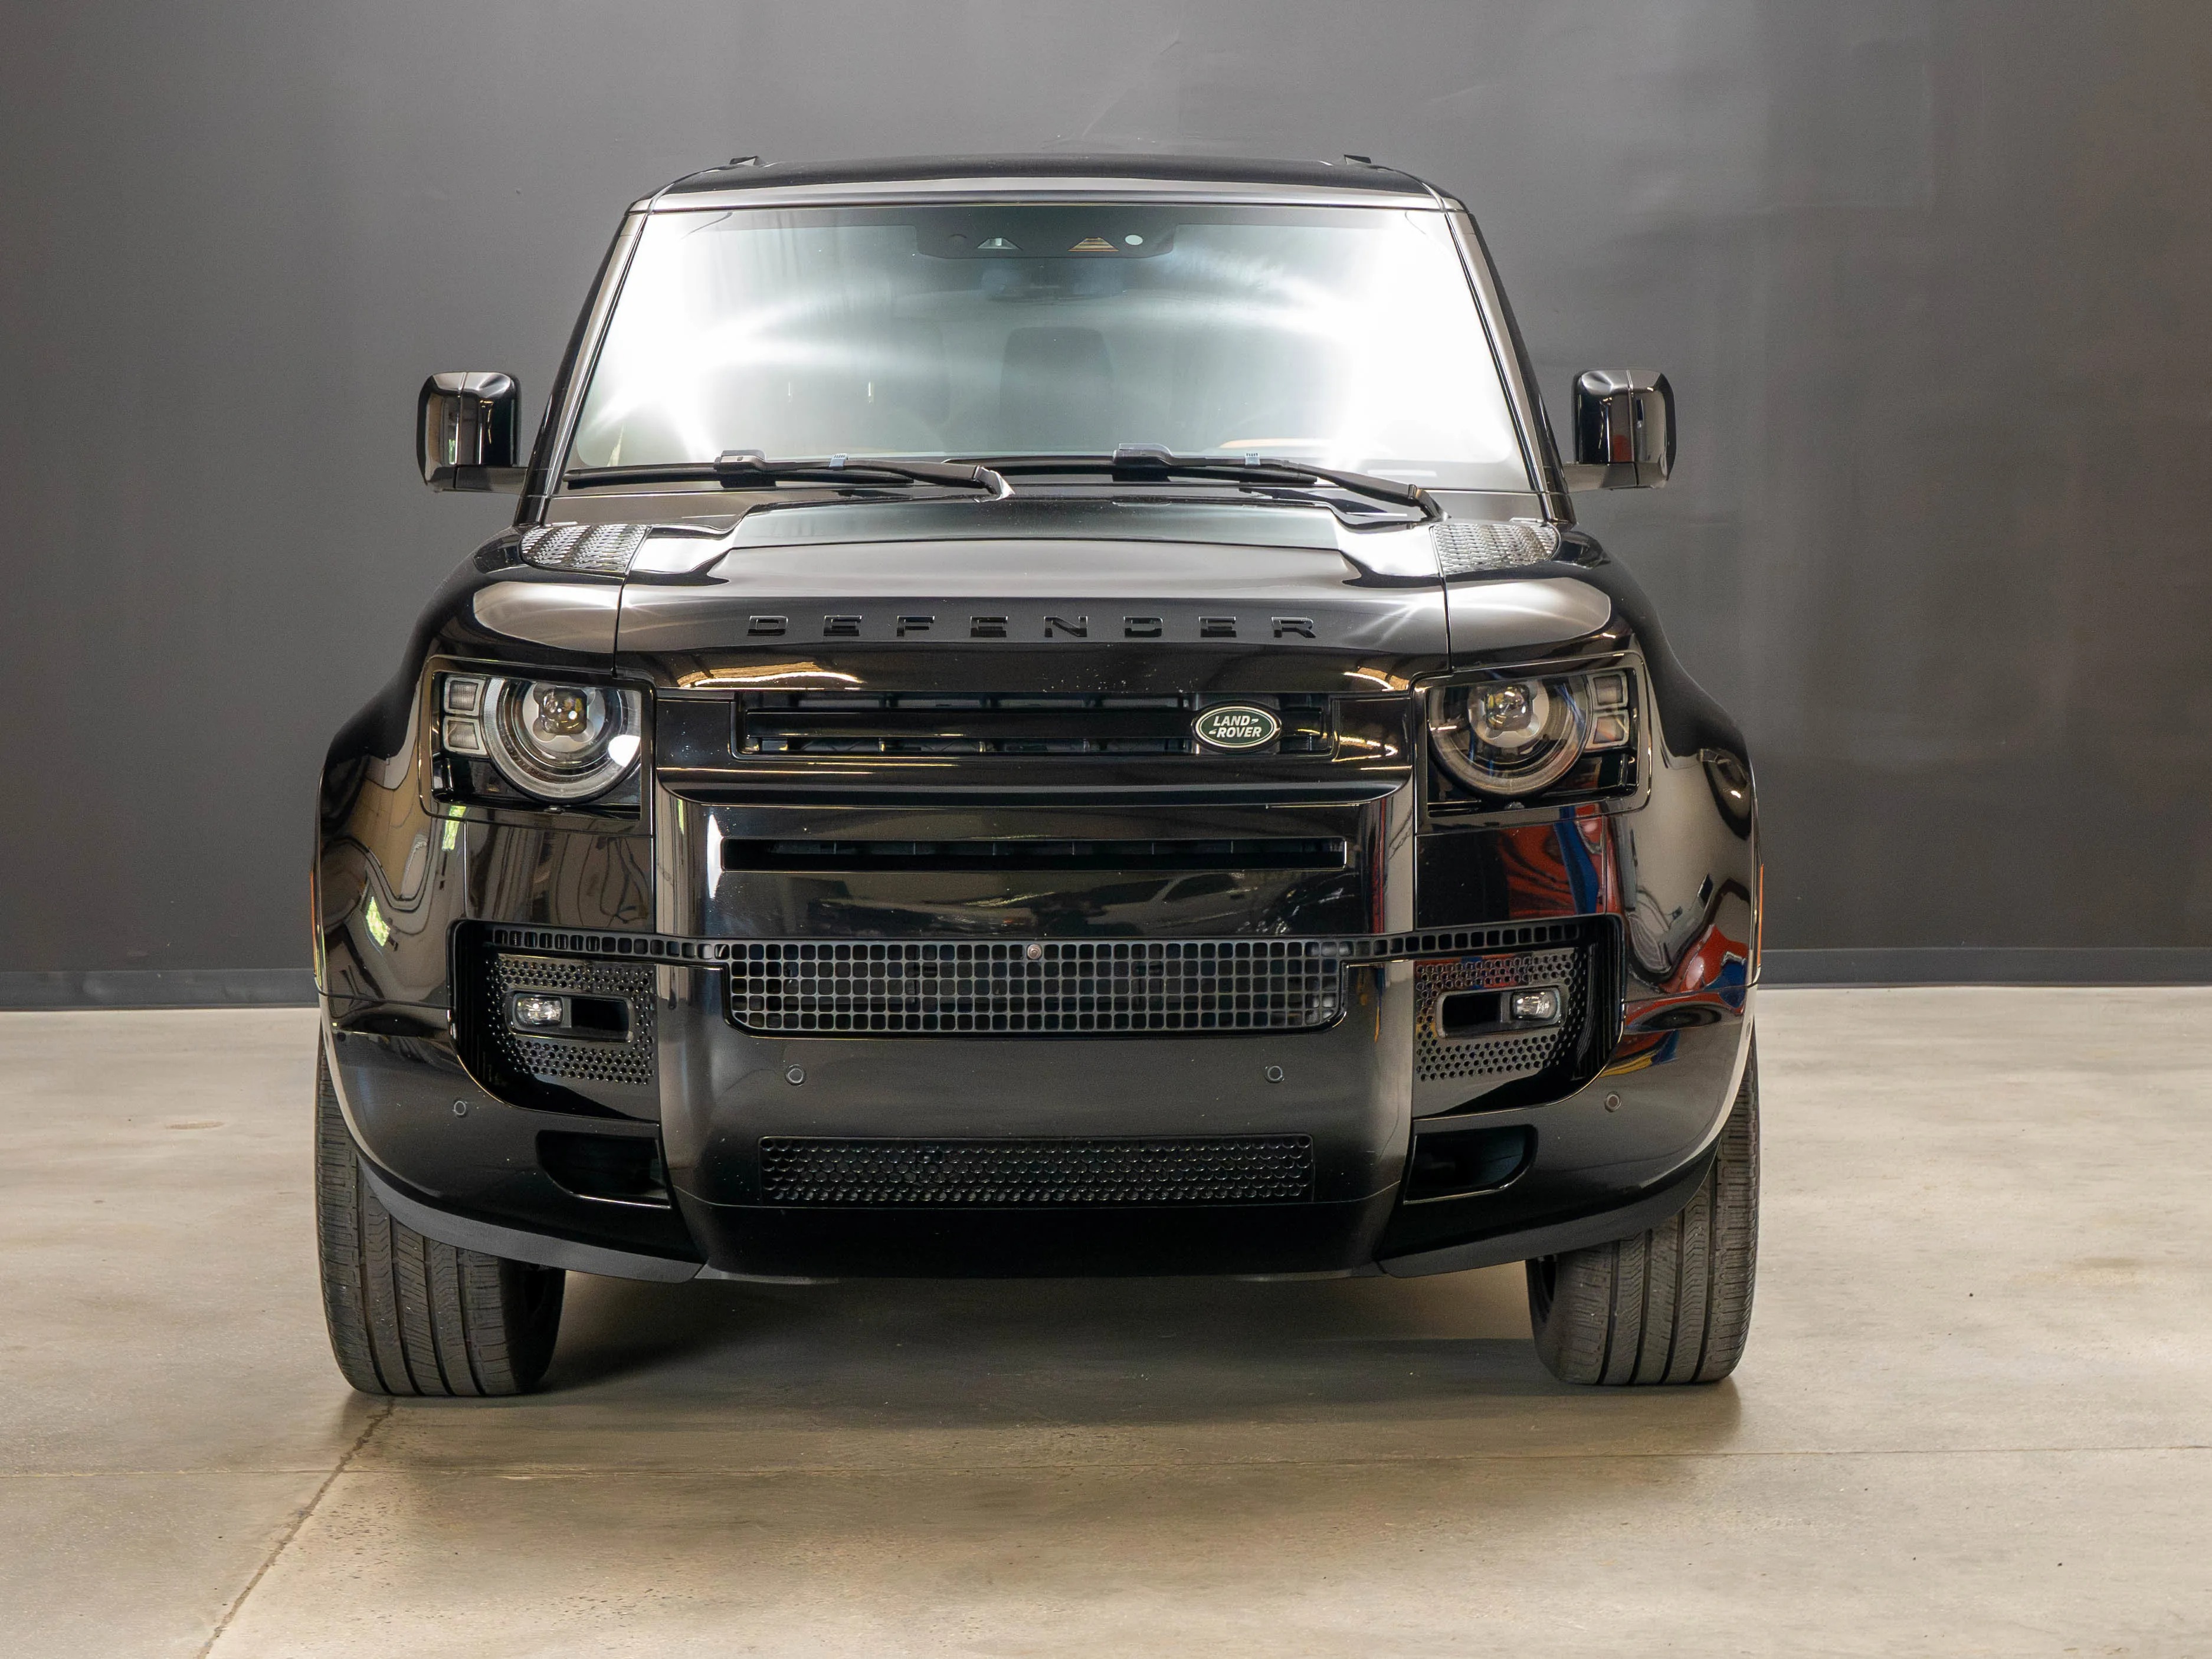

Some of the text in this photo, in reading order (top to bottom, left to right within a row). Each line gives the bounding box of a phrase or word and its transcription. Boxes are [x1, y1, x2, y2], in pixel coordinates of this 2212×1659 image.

[747, 615, 1316, 638] DEFENDER
[1213, 716, 1251, 726] LAND
[1217, 727, 1262, 737] ROVER
